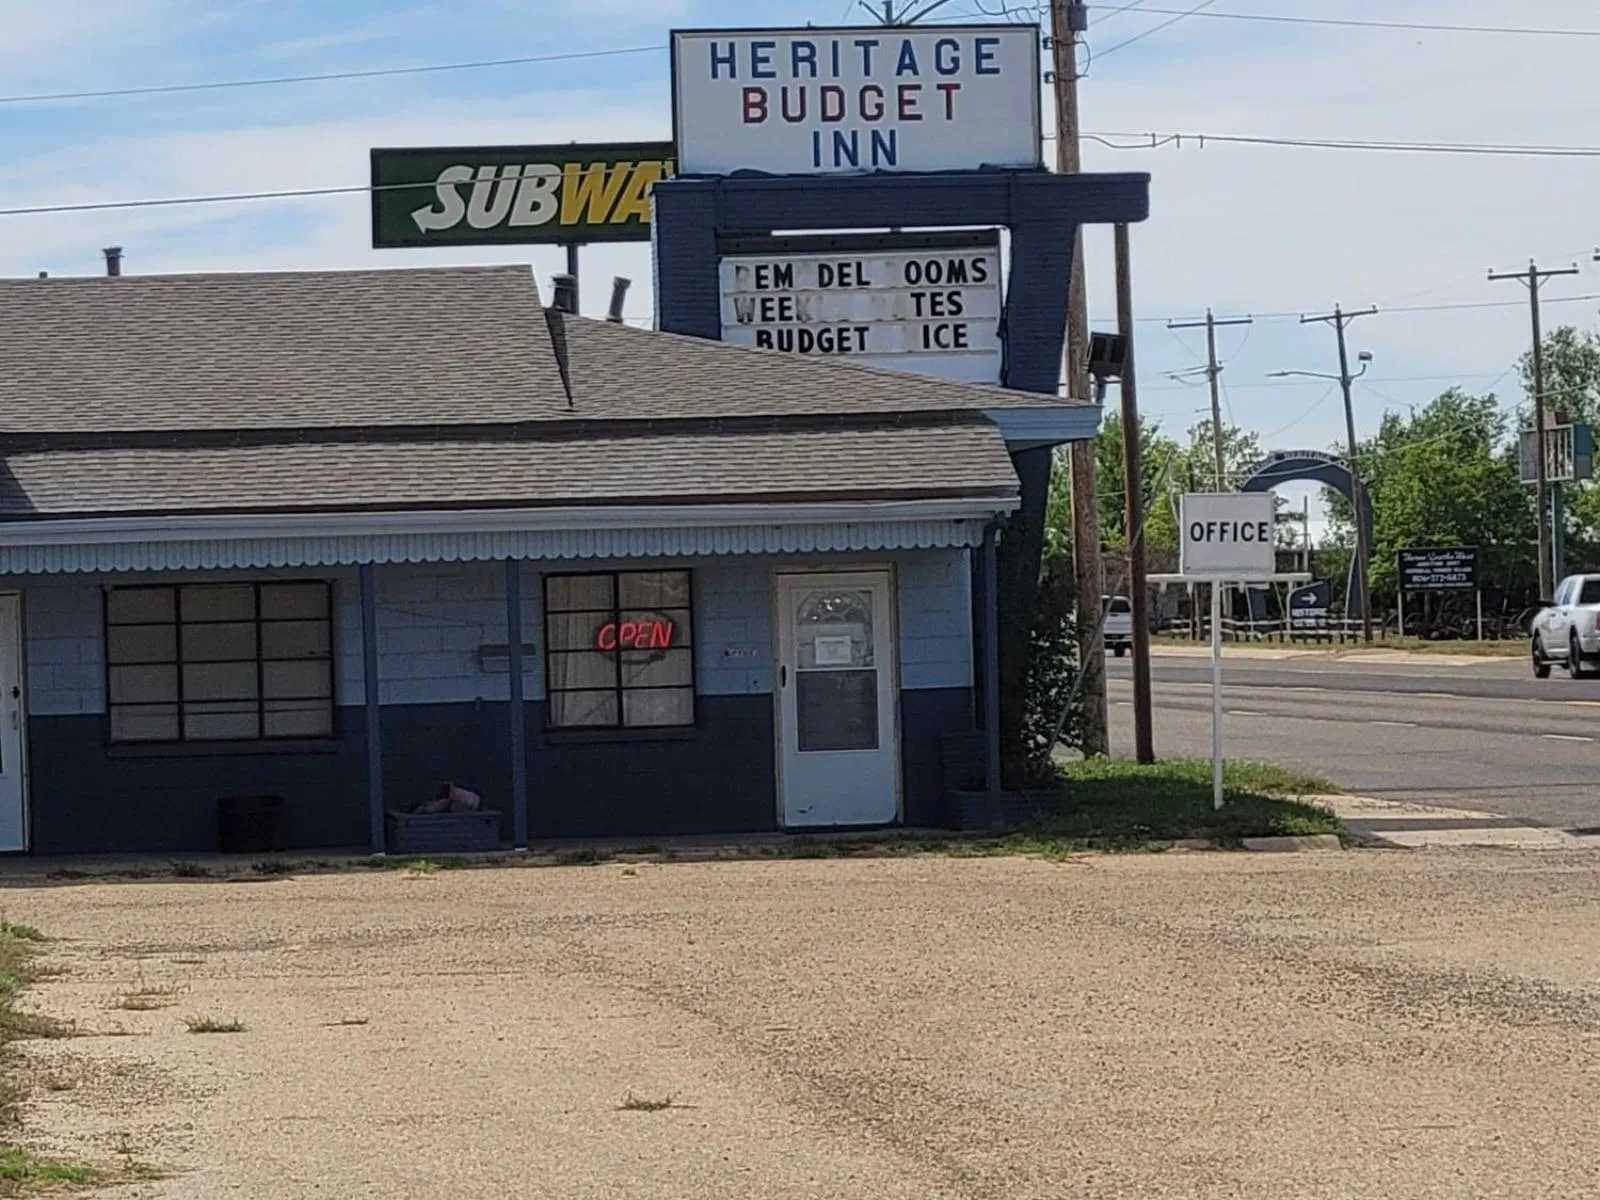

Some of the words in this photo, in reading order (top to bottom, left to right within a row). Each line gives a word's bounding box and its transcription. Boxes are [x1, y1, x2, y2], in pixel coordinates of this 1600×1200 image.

[711, 37, 1001, 79] HERITAGE
[742, 83, 961, 123] BUDGET
[813, 129, 897, 167] INN
[411, 160, 675, 235] SUBWA
[818, 261, 871, 288] DEL
[757, 326, 869, 353] BUDGET
[1190, 521, 1269, 542] OFFICE
[598, 621, 672, 649] OPEN
